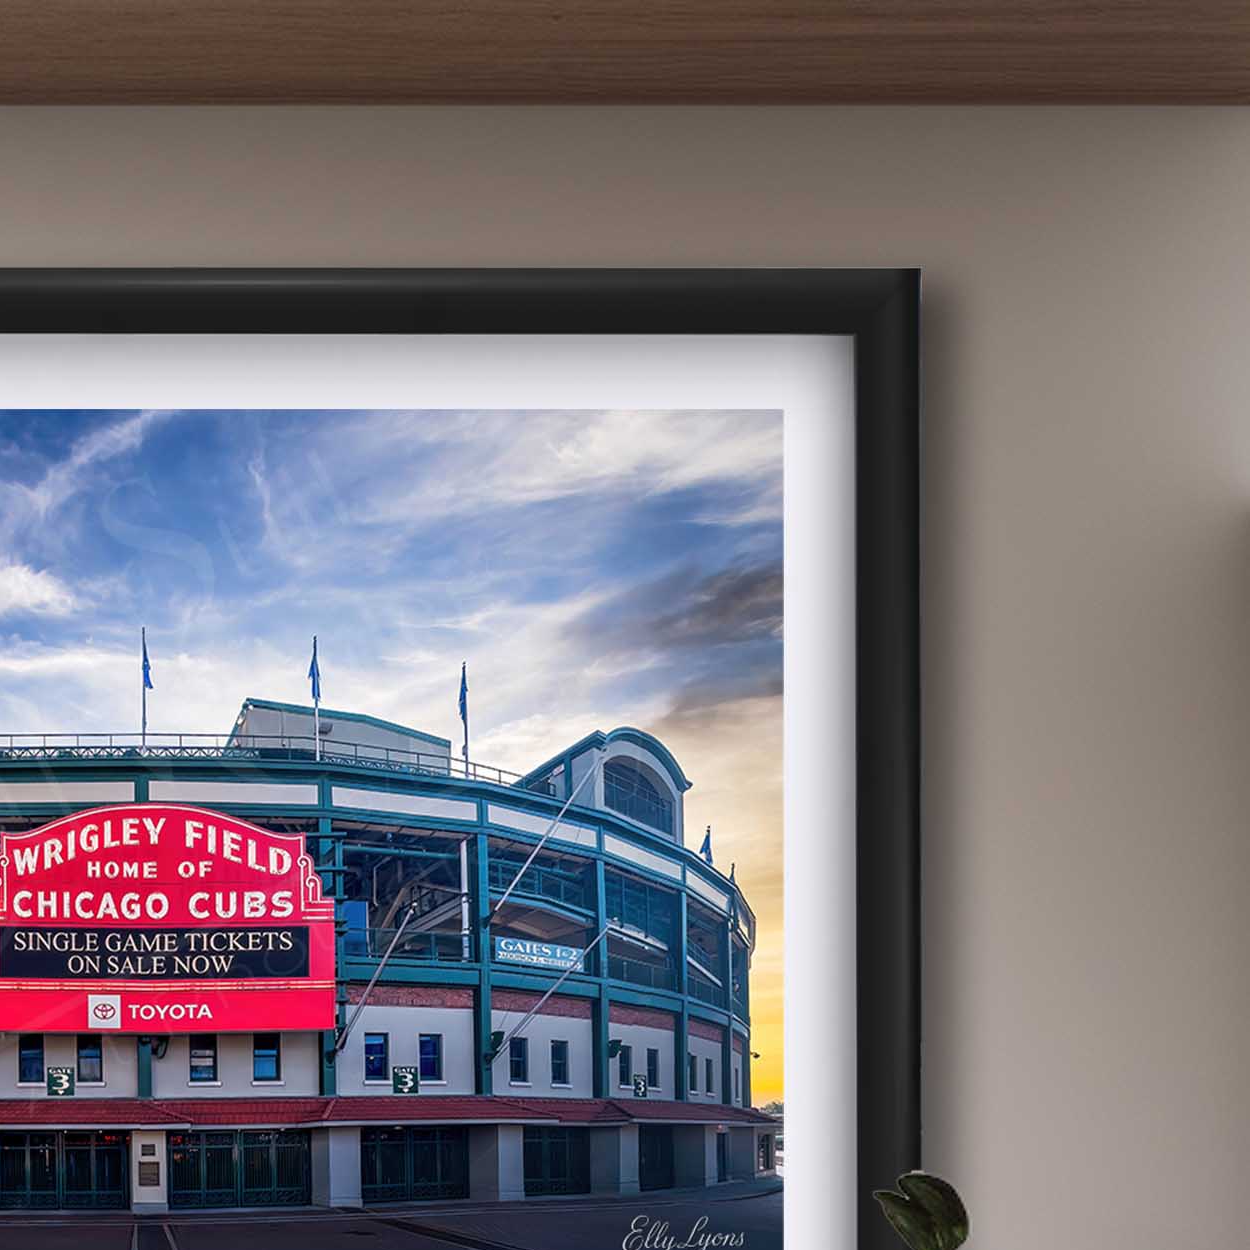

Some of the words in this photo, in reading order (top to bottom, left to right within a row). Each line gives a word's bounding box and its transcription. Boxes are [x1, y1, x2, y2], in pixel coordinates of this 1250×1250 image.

[13, 817, 166, 876] WRIGLEY
[185, 819, 293, 876] FIELD
[87, 861, 158, 879] HOME
[177, 861, 213, 878] OF
[13, 890, 169, 920] CHICAGO
[188, 891, 294, 919] CUBS
[13, 931, 99, 951] SINGLE
[105, 932, 178, 952] GAME
[184, 931, 293, 951] TICKETS
[500, 939, 551, 956] GATES
[67, 955, 100, 974] ON
[107, 955, 166, 975] SALE
[173, 955, 234, 975] NOW
[128, 1004, 213, 1020] TOYOTA
[52, 1073, 70, 1090] 3
[397, 1072, 414, 1089] 3
